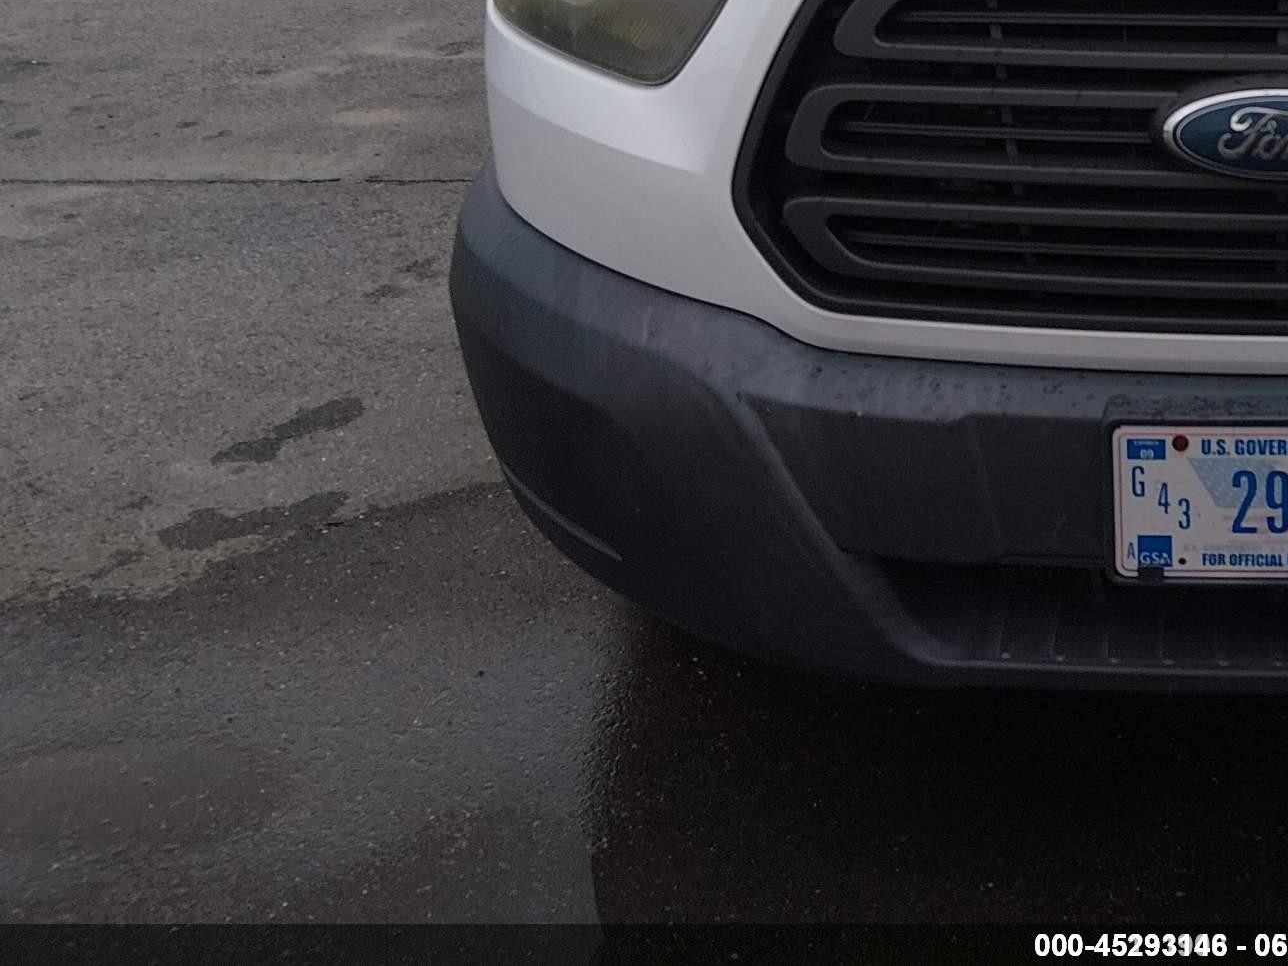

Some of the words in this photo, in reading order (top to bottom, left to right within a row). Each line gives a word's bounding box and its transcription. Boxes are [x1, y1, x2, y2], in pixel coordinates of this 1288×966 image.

[1201, 439, 1231, 456] U.S.
[1139, 552, 1171, 565] GSA
[1202, 553, 1225, 567] FOR
[1229, 553, 1282, 568] OFFICIAL
